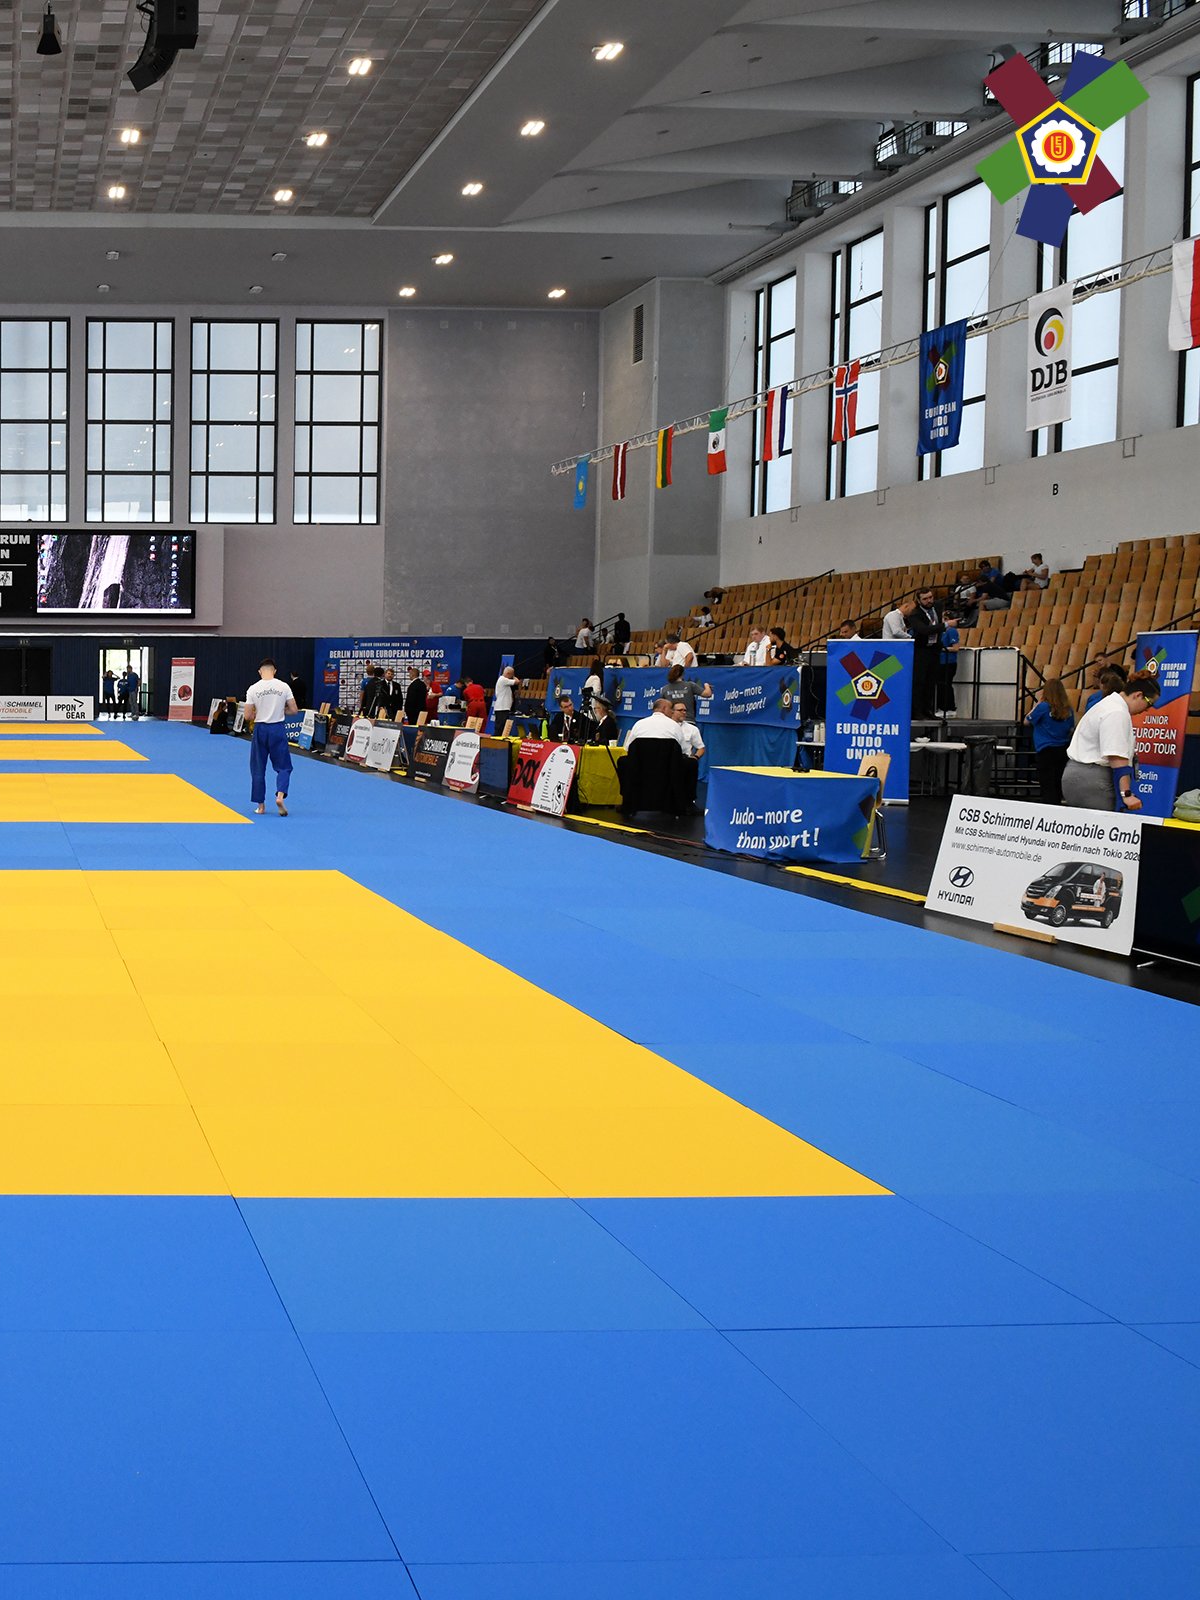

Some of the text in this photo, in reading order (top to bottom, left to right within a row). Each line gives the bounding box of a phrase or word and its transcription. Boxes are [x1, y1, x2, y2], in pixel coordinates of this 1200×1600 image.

[1030, 359, 1068, 392] DJB
[925, 401, 956, 418] EUROPEAN
[1052, 484, 1059, 496] B
[758, 536, 762, 544] A
[330, 650, 444, 658] BERLIN JUNIOR EUROPEAN CUP 2023
[256, 688, 283, 699] Deutschland
[730, 697, 766, 714] than sport!
[1143, 715, 1168, 724] JUNIOR
[836, 723, 899, 735] EUROPEAN
[1132, 728, 1177, 740] EUROPEAN
[851, 736, 882, 748] JUDO
[846, 748, 885, 760] UNIO
[1153, 743, 1176, 755] TOUR
[1139, 784, 1153, 794] GER
[959, 808, 1140, 844] CSB Schimmel Automobile Gmb
[736, 831, 766, 848] than
[965, 828, 977, 836] CSB
[978, 829, 1006, 841] Schimmel
[1007, 834, 1018, 843] und
[1020, 835, 1046, 847] Hyundai
[1048, 841, 1060, 849] von
[1061, 842, 1082, 852] Berlin
[1082, 845, 1101, 855] nach
[1103, 848, 1122, 859] Tokio
[951, 840, 1042, 862] www.schimmel-automobile.de
[937, 890, 975, 906] HYUNDAI
